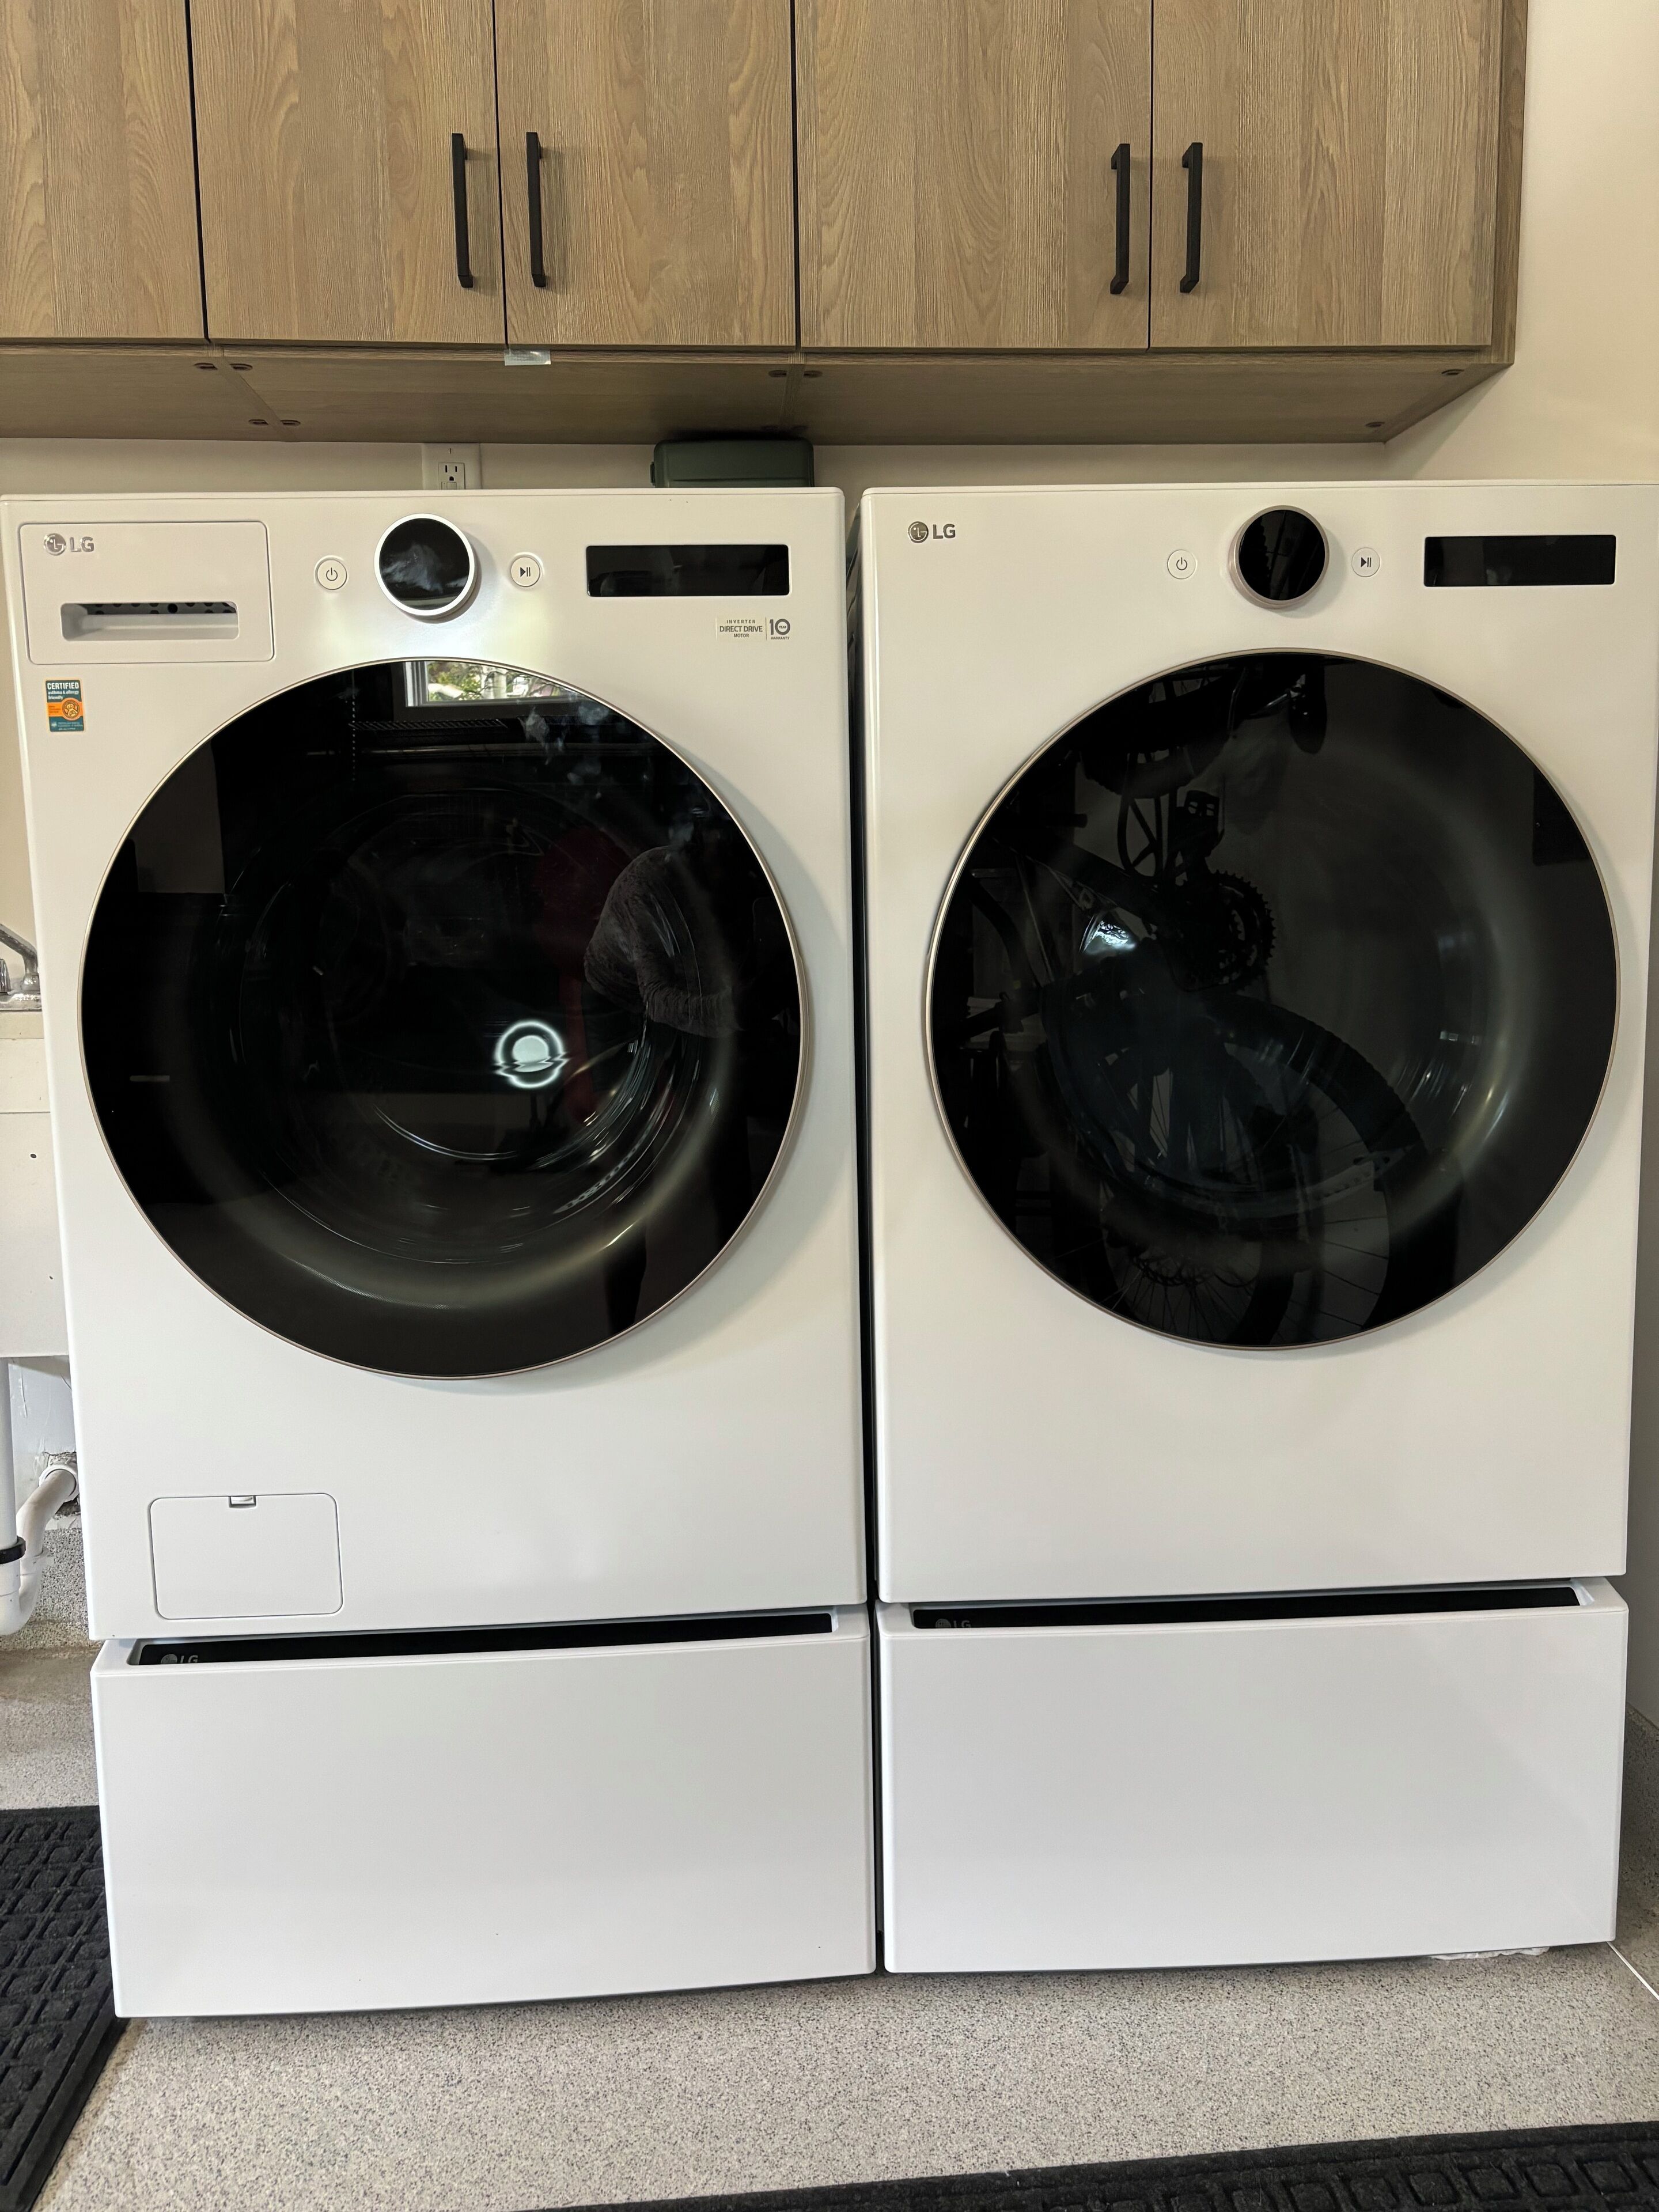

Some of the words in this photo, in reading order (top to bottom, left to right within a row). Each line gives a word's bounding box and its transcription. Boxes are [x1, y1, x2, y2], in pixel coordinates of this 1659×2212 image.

[933, 524, 956, 539] LG
[70, 536, 94, 552] LG
[769, 619, 791, 635] 10
